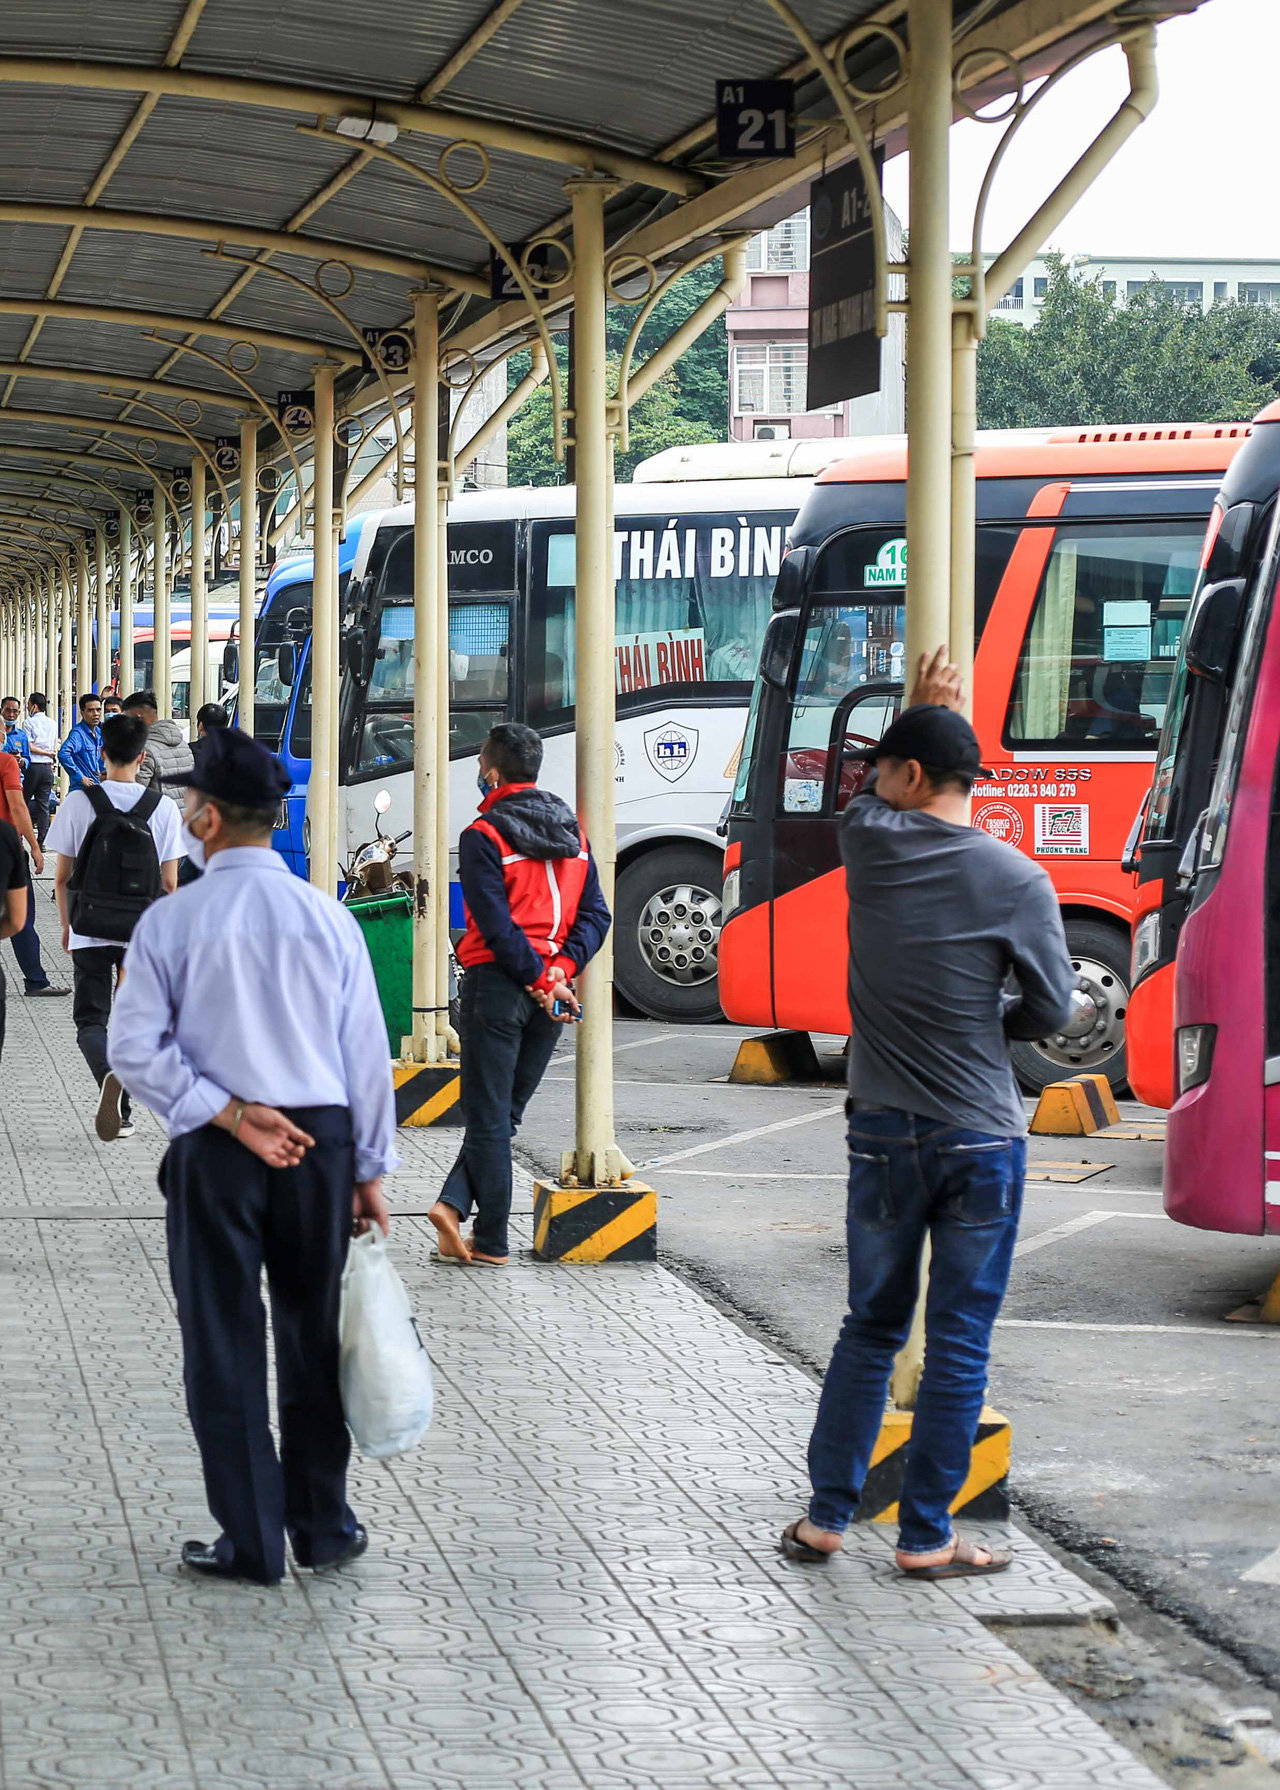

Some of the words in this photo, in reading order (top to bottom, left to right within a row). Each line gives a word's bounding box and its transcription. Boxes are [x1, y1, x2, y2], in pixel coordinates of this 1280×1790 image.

[723, 86, 745, 103] A1
[737, 109, 786, 150] 21
[841, 187, 872, 229] A1-2
[366, 331, 379, 342] A1
[280, 394, 292, 403] A1
[284, 405, 312, 425] 24
[613, 519, 697, 580] THÁI
[710, 516, 794, 578] BÌN
[447, 549, 494, 565] MCO
[868, 568, 896, 582] NAM
[1159, 636, 1180, 657] MIỄ
[656, 631, 705, 685] BÌNH
[970, 783, 1006, 797] Hotline:
[1007, 783, 1038, 797] 0228.3
[1040, 783, 1057, 797] 840
[1059, 783, 1077, 797] 279
[1036, 846, 1063, 854] PHƯƠNG
